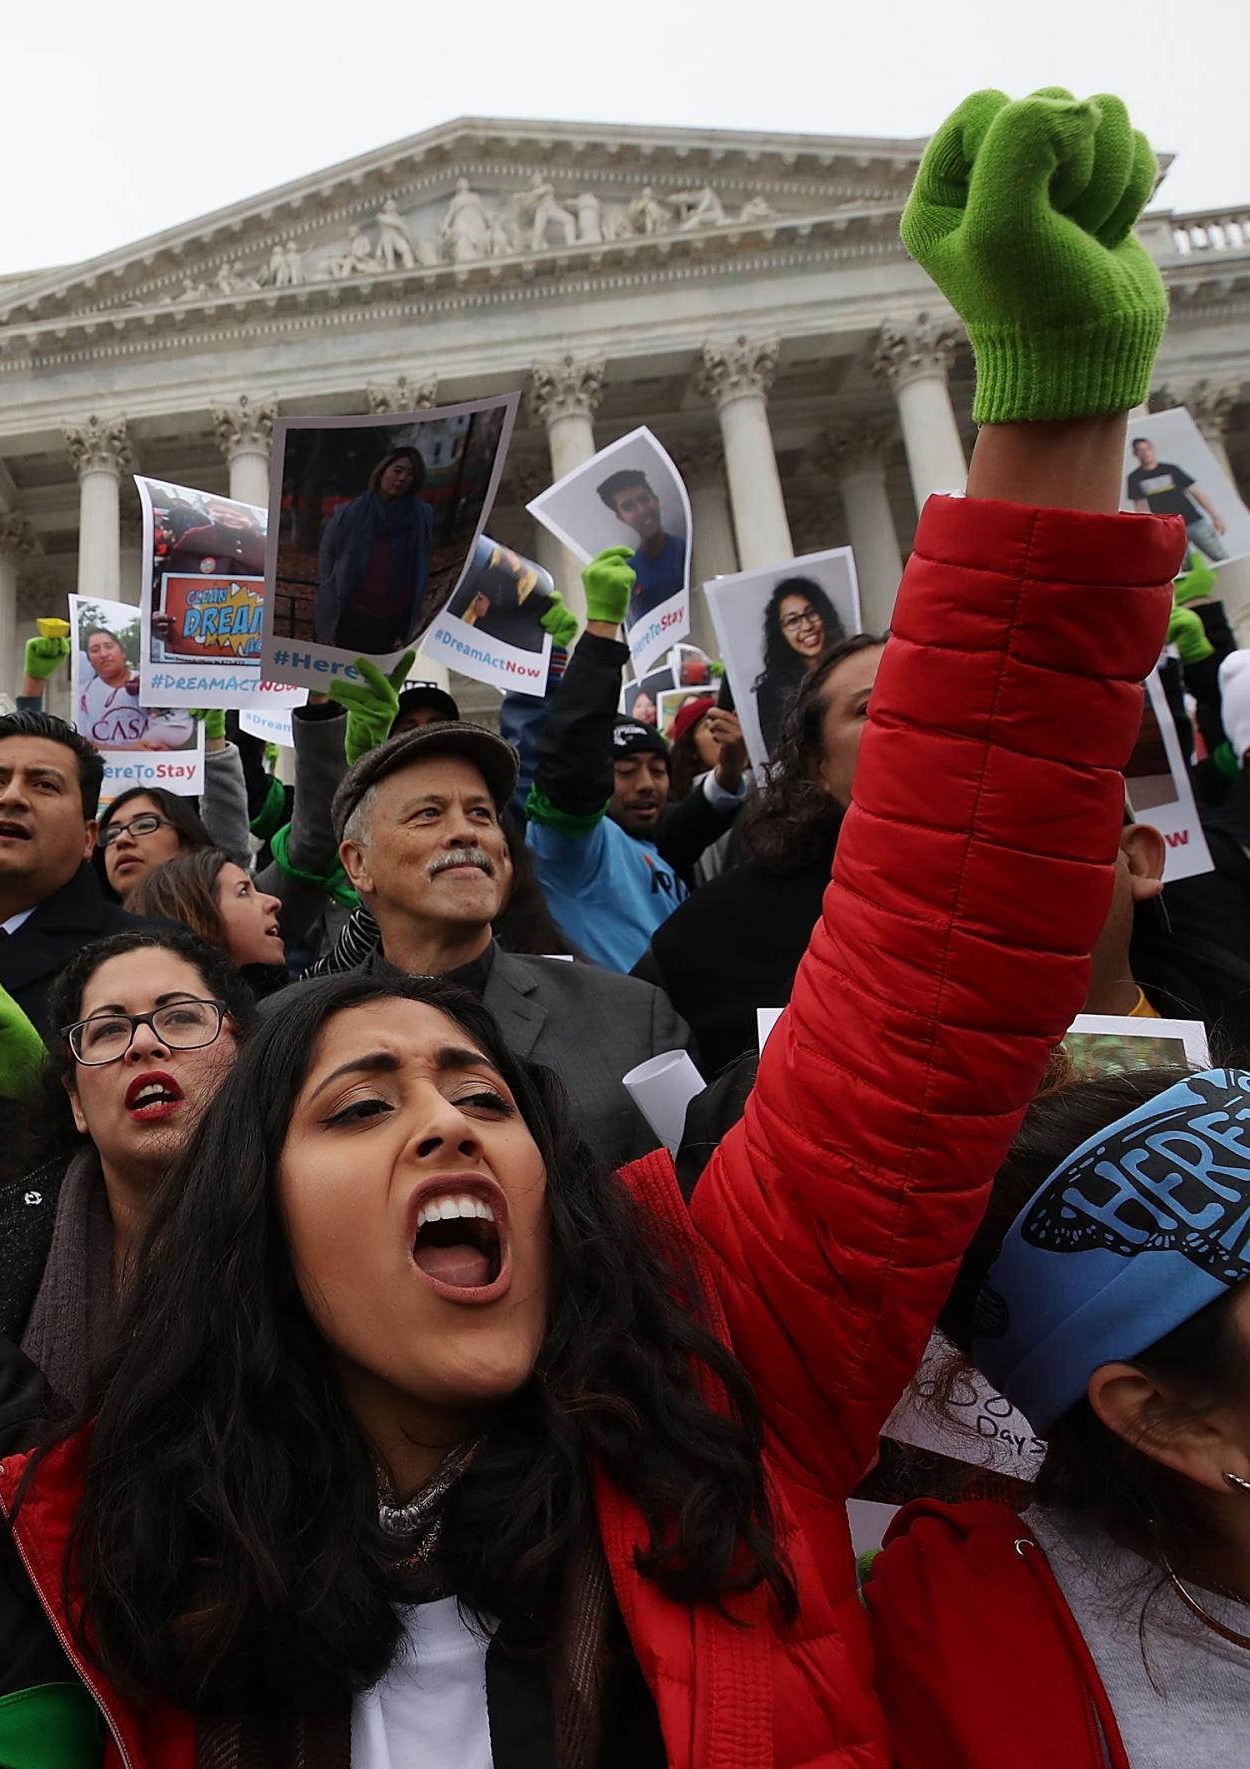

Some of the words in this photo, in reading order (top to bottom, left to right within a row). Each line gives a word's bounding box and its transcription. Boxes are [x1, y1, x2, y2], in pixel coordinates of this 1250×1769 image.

[186, 588, 228, 605] CLEAN
[435, 629, 540, 678] #DreamActNow
[977, 1414, 1046, 1456] Days
